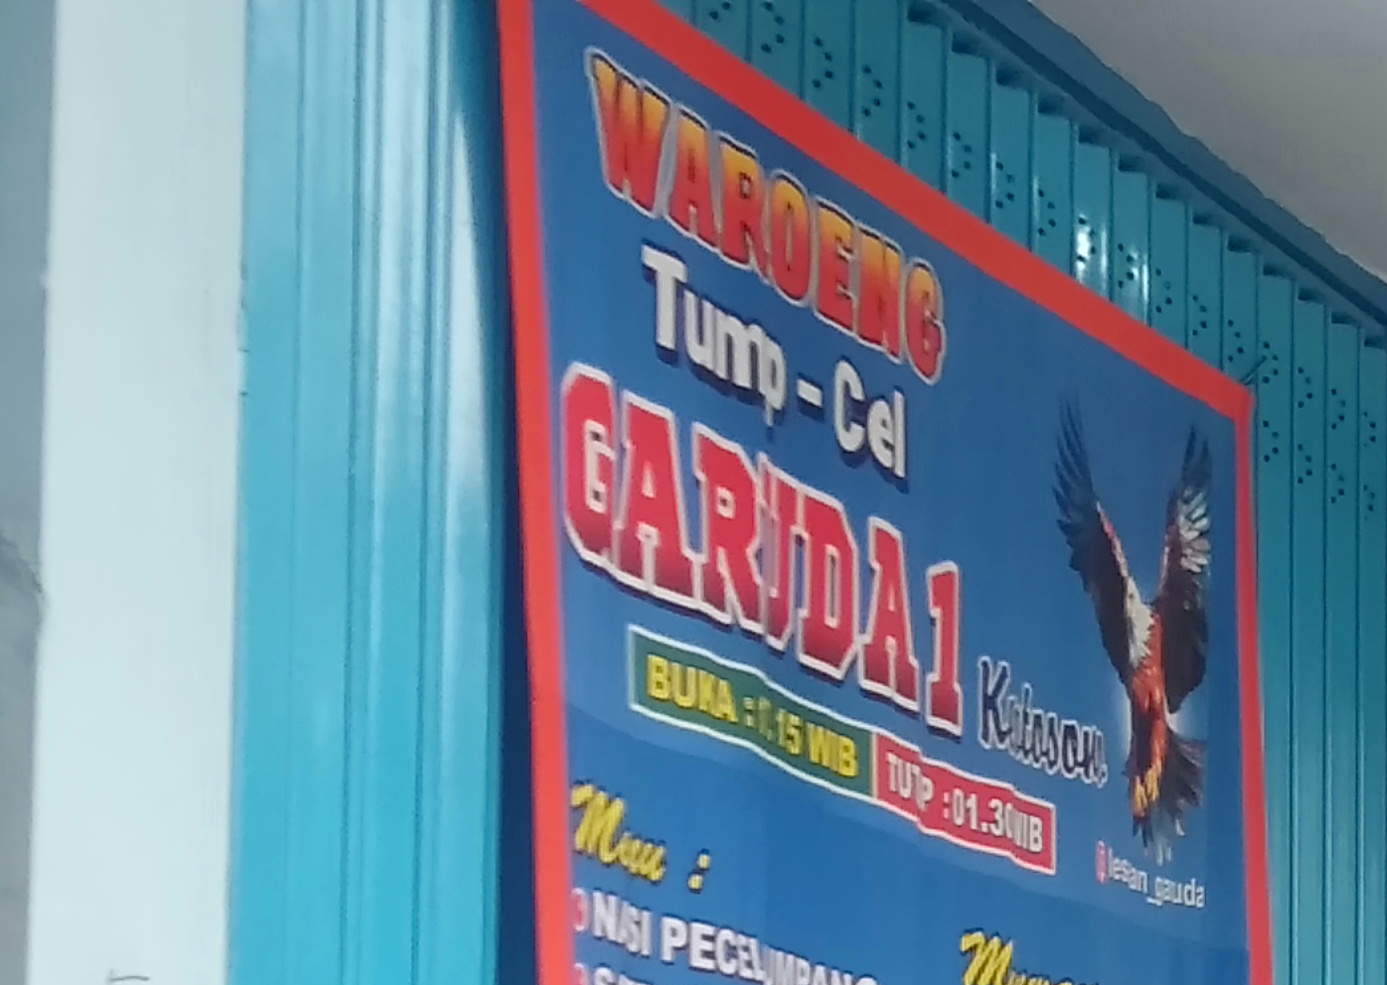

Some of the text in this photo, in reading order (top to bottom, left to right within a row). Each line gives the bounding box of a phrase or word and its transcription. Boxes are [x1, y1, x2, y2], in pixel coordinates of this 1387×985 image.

[587, 47, 945, 384] WAROENG
[834, 361, 907, 478] Cel
[927, 562, 962, 735] 1
[807, 722, 859, 777] WIB
